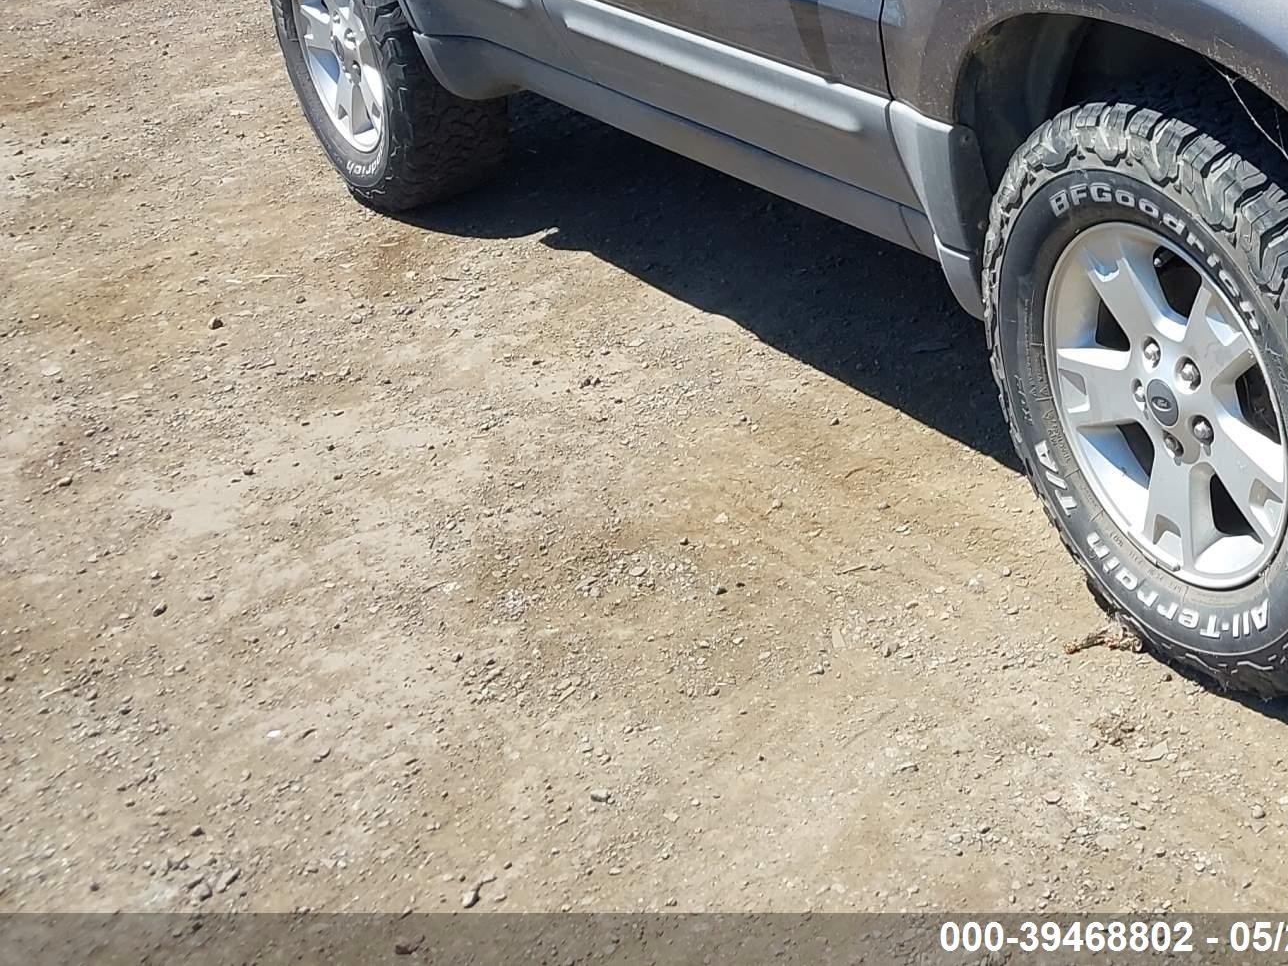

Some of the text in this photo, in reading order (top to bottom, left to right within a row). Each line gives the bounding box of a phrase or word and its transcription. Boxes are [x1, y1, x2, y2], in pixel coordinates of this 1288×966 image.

[1049, 183, 1260, 334] BFGoodrich
[1034, 439, 1078, 518] T/A
[1086, 531, 1270, 640] All-Terrain
